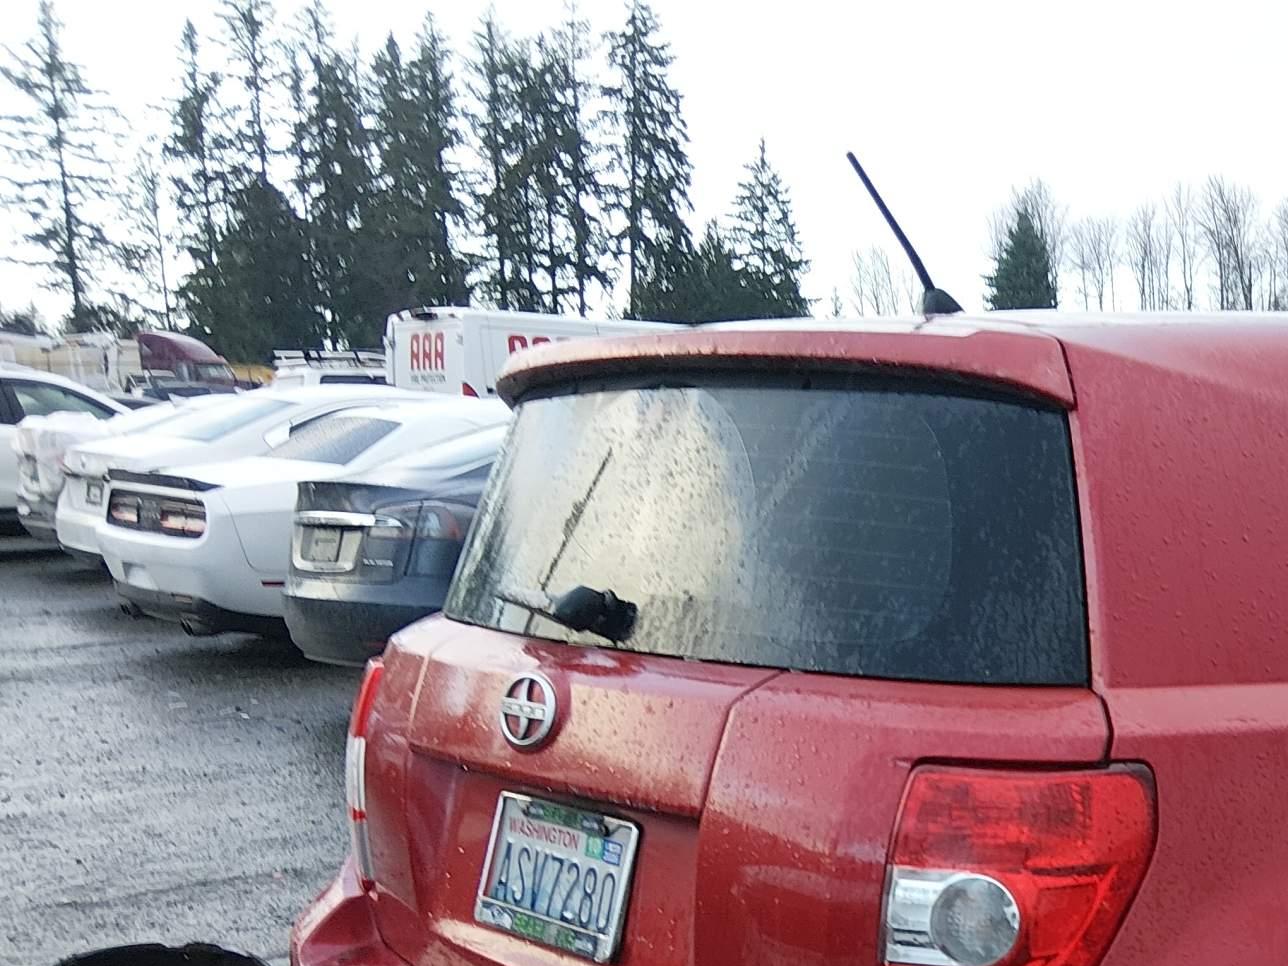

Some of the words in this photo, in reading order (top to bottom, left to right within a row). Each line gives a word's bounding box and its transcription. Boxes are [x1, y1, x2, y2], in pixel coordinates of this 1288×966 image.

[410, 332, 445, 371] AAA
[509, 816, 581, 851] WASHINGTON
[495, 839, 617, 935] ASV7280
